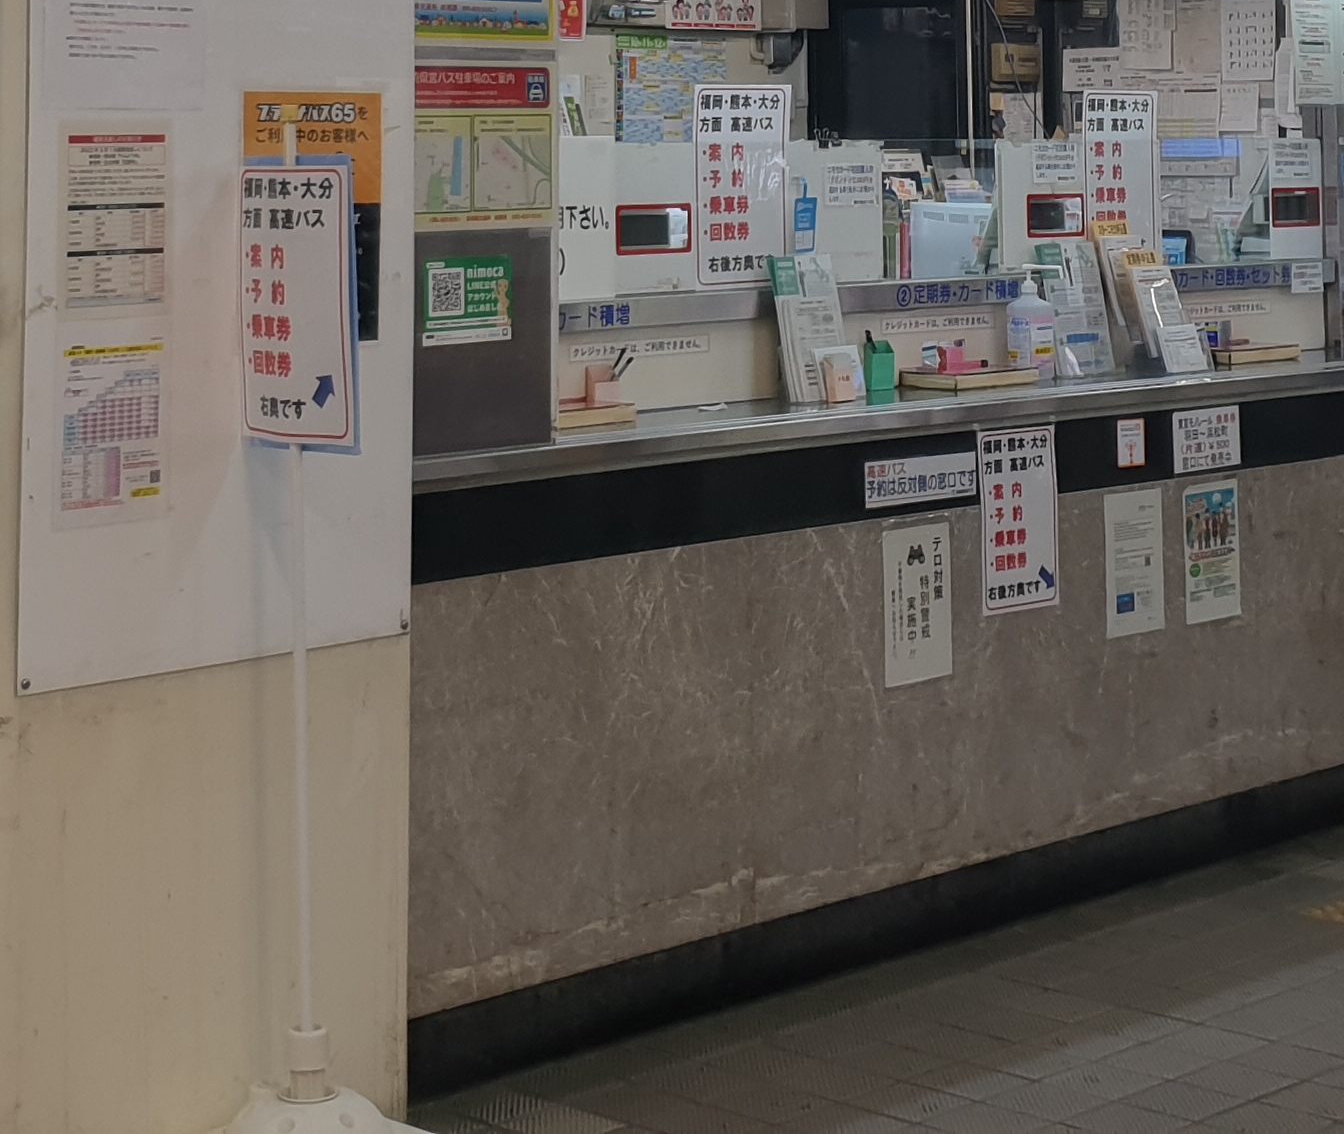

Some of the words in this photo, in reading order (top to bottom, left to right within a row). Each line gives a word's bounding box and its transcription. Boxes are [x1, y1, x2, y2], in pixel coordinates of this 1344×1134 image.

[700, 93, 780, 112] 福岡・熊本・大分
[700, 116, 722, 133] 方面
[730, 116, 775, 133] 高速バス
[1110, 117, 1145, 133] 高速バス
[243, 177, 334, 200] 福岡・熊本・大分
[242, 208, 262, 229] 方面
[269, 207, 326, 229] 高速バス
[467, 265, 504, 278] nimoca
[260, 397, 307, 420] 右奥です
[867, 462, 906, 478] 高速バス
[1009, 455, 1044, 472] 高速バス
[866, 469, 976, 498] 予約は反対側の窓口です
[932, 536, 944, 600] テロ対策
[919, 574, 931, 639] 特別警戒
